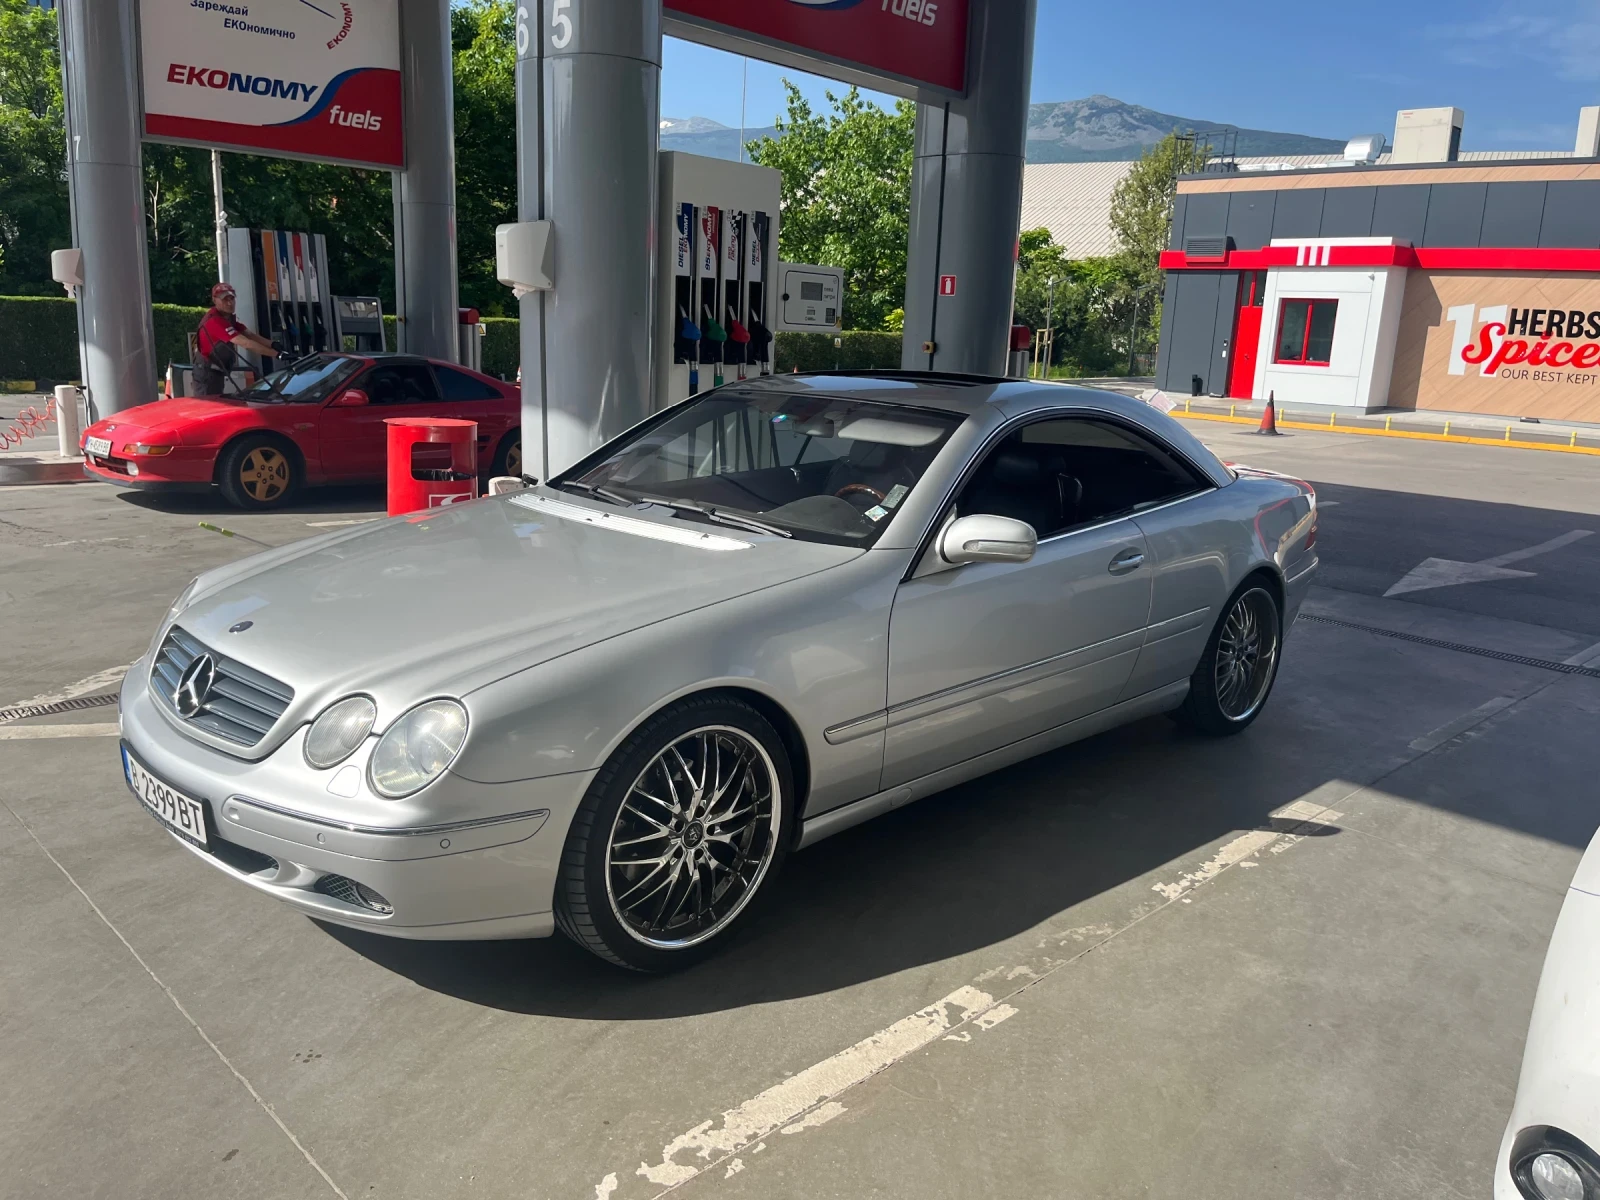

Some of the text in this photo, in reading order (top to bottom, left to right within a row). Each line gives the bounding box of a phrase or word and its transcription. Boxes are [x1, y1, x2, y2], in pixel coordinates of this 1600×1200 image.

[190, 0, 248, 16] Зареждай
[223, 18, 296, 40] ЕКОномично
[326, 2, 353, 50] EKONOMY
[516, 6, 530, 56] 6
[551, 0, 572, 49] 5
[166, 63, 319, 103] EKONOMY
[329, 105, 382, 131] fuels
[1508, 308, 1600, 339] HERBS
[1501, 368, 1598, 385] OUR BEST KEPT
